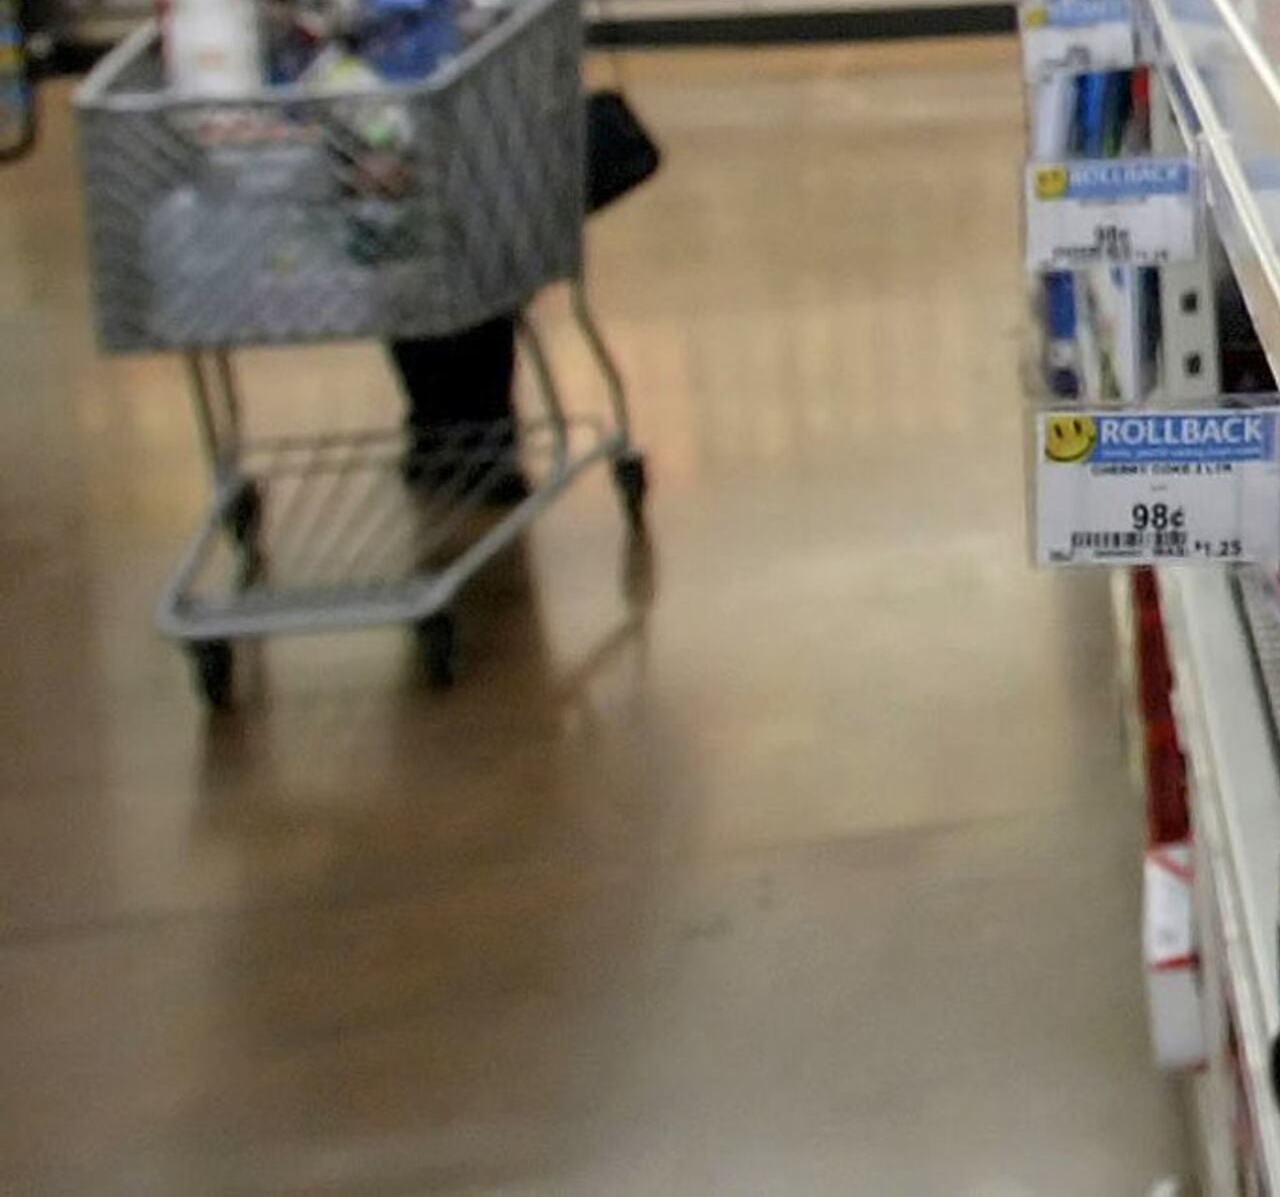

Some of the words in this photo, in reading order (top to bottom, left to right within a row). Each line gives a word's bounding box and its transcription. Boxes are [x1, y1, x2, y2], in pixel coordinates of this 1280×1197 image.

[1100, 417, 1263, 444] ROLLBACK
[1131, 502, 1186, 531] 98¢
[1194, 539, 1243, 558] $1.25
